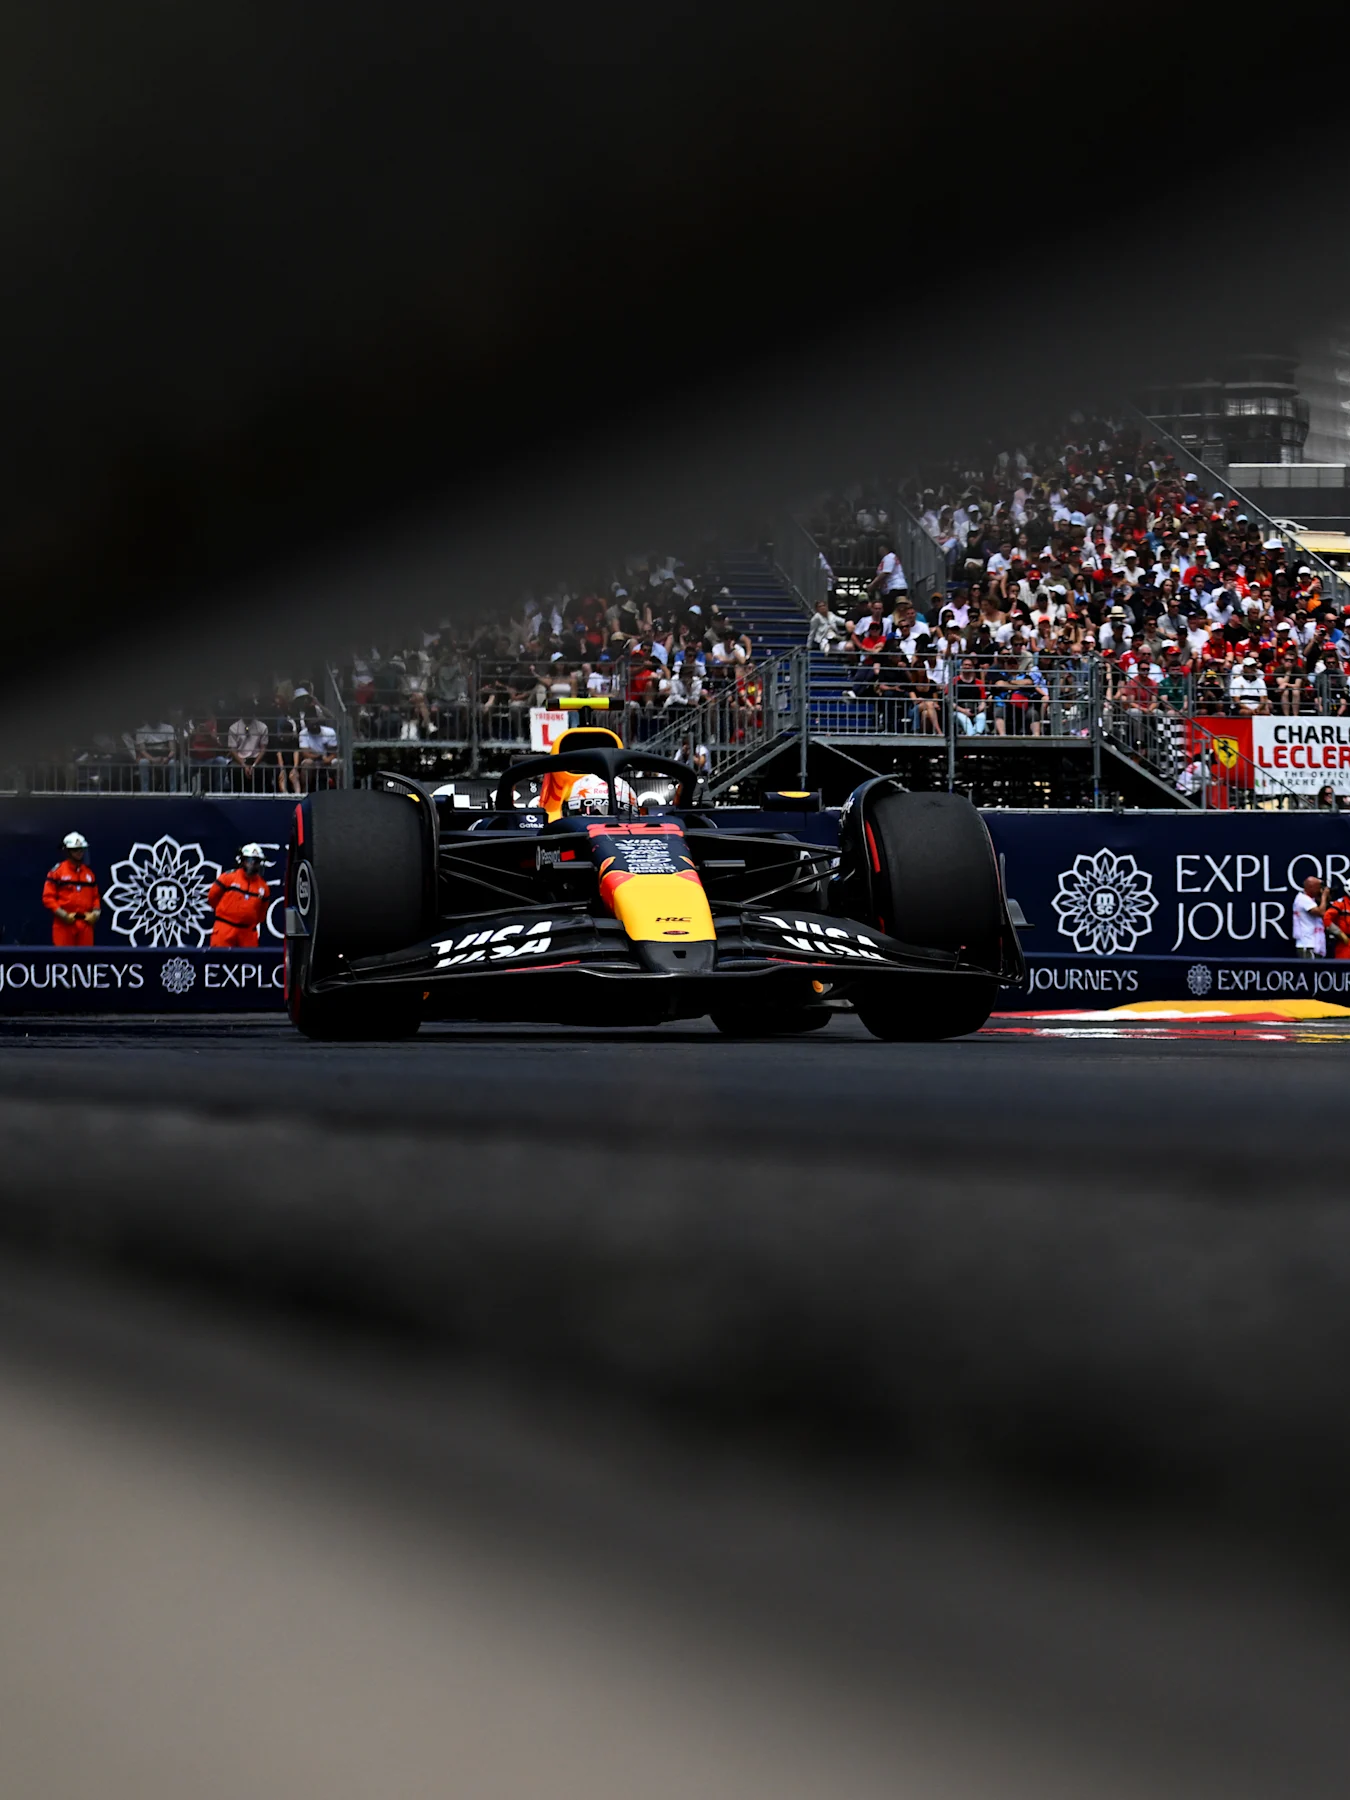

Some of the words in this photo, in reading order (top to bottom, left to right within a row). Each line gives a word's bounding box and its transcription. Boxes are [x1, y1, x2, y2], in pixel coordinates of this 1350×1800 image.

[1324, 778, 1345, 787] FAN
[1027, 968, 1139, 994] JOURNEYS
[1217, 970, 1308, 992] EXPLORA
